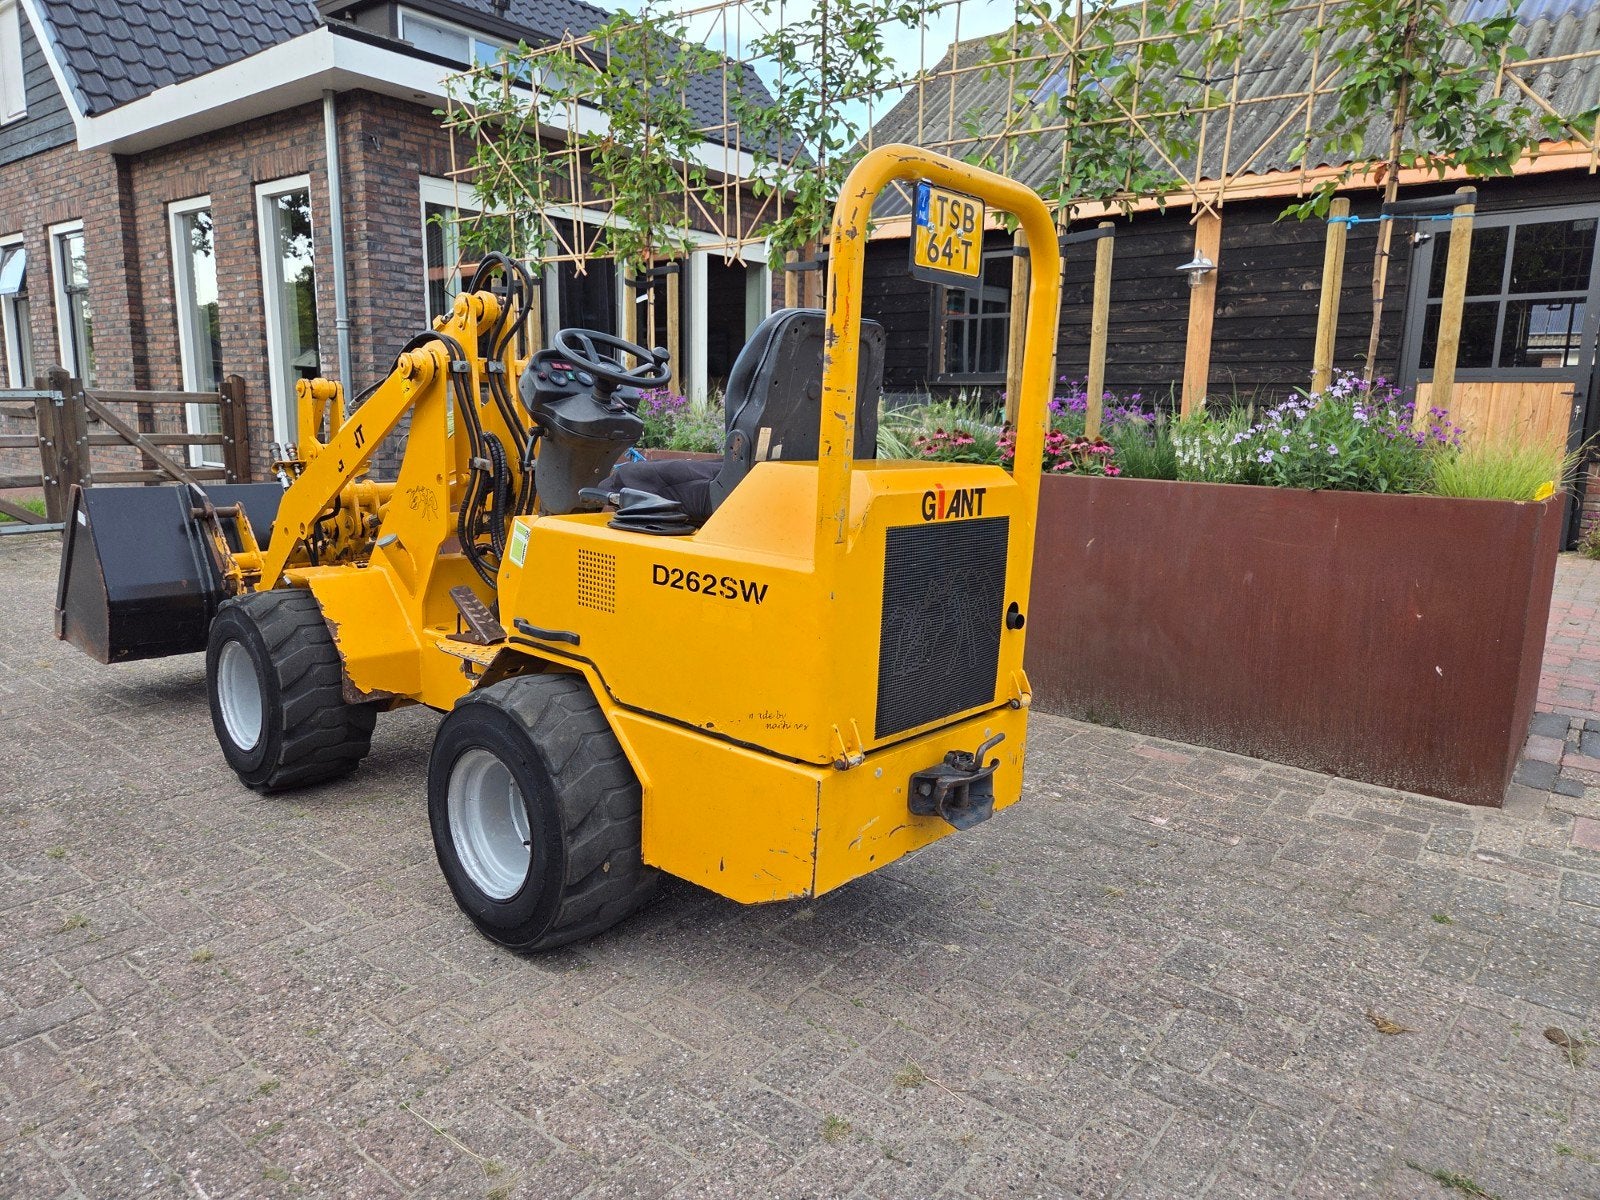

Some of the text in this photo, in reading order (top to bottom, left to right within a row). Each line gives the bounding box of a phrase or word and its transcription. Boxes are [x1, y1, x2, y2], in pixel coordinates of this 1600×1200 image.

[937, 195, 975, 233] TSB
[927, 233, 972, 270] 64-T
[921, 483, 986, 521] GIANT
[652, 563, 769, 605] D262SW
